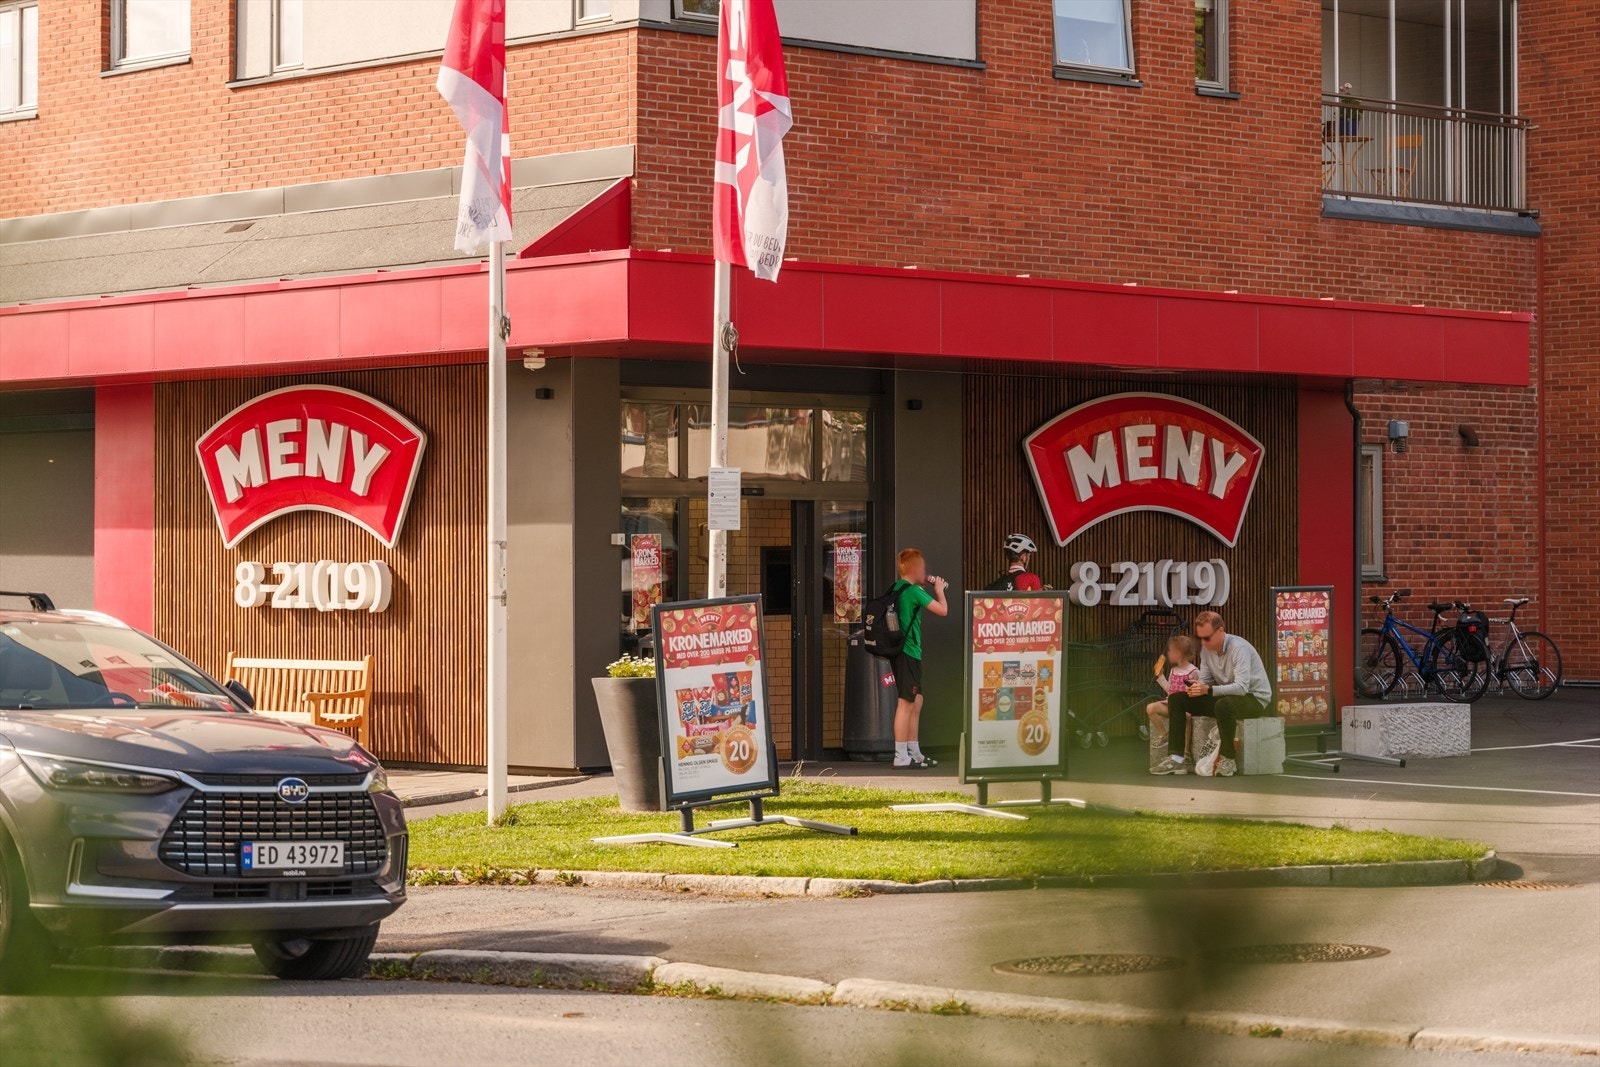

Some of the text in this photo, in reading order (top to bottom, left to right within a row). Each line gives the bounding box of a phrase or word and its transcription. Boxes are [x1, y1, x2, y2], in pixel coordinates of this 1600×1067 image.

[215, 418, 391, 504] MENY
[1064, 424, 1246, 502] MENY
[634, 556, 659, 566] MARKED
[836, 554, 859, 563] MARKED
[235, 560, 391, 613] 8-21(19)
[1070, 559, 1230, 608] 8-21(19)
[700, 614, 720, 624] MENY
[1280, 607, 1327, 620] KRONEMARKED
[978, 621, 1055, 638] KRONEMARKED
[669, 629, 752, 652] KRONEMARKED
[687, 650, 699, 658] OVER
[1025, 724, 1044, 743] 20
[730, 740, 749, 761] 20
[282, 785, 306, 796] BYD
[257, 845, 338, 864] ED 43972
